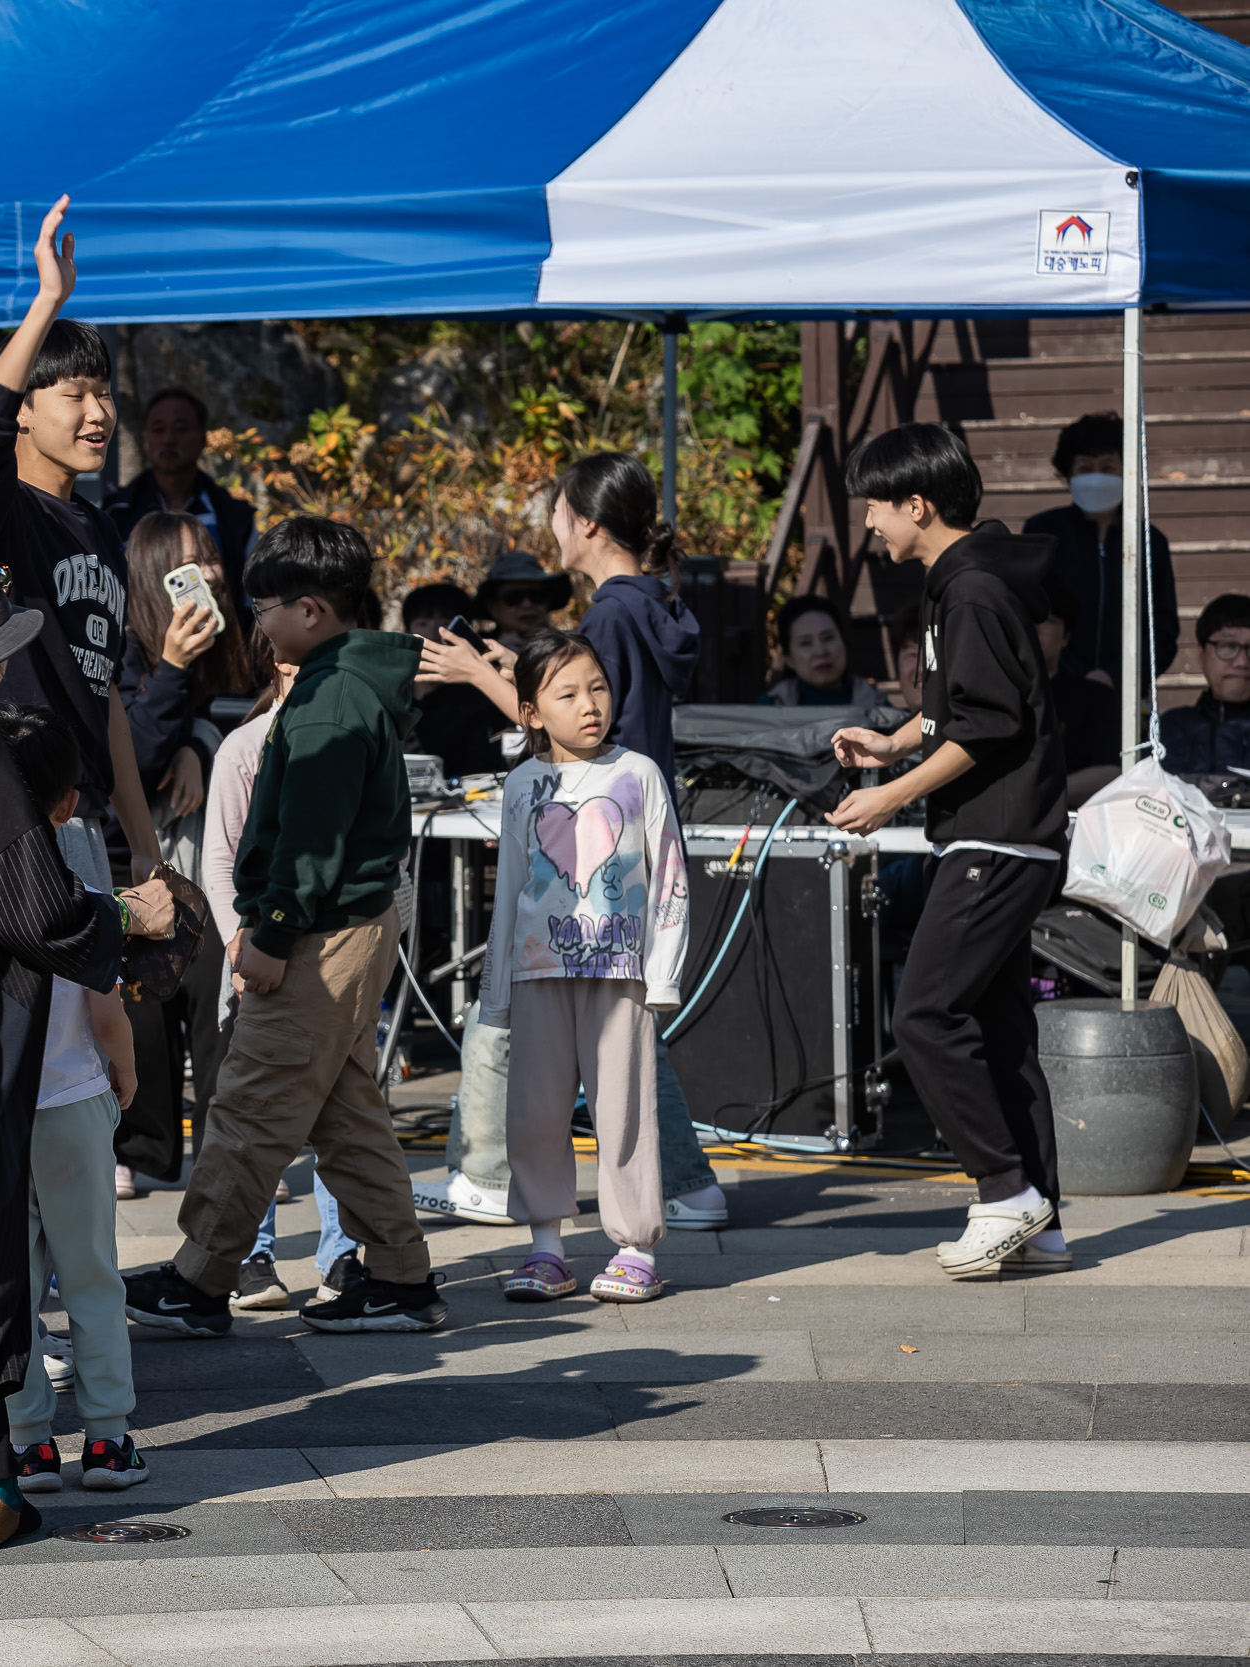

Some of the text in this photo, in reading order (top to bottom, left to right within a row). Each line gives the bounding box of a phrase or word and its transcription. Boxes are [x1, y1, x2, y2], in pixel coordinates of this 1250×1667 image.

[1044, 256, 1101, 271] 대승캐노피
[271, 910, 285, 922] G
[413, 1193, 457, 1212] crocs
[986, 1230, 1024, 1260] crocs
